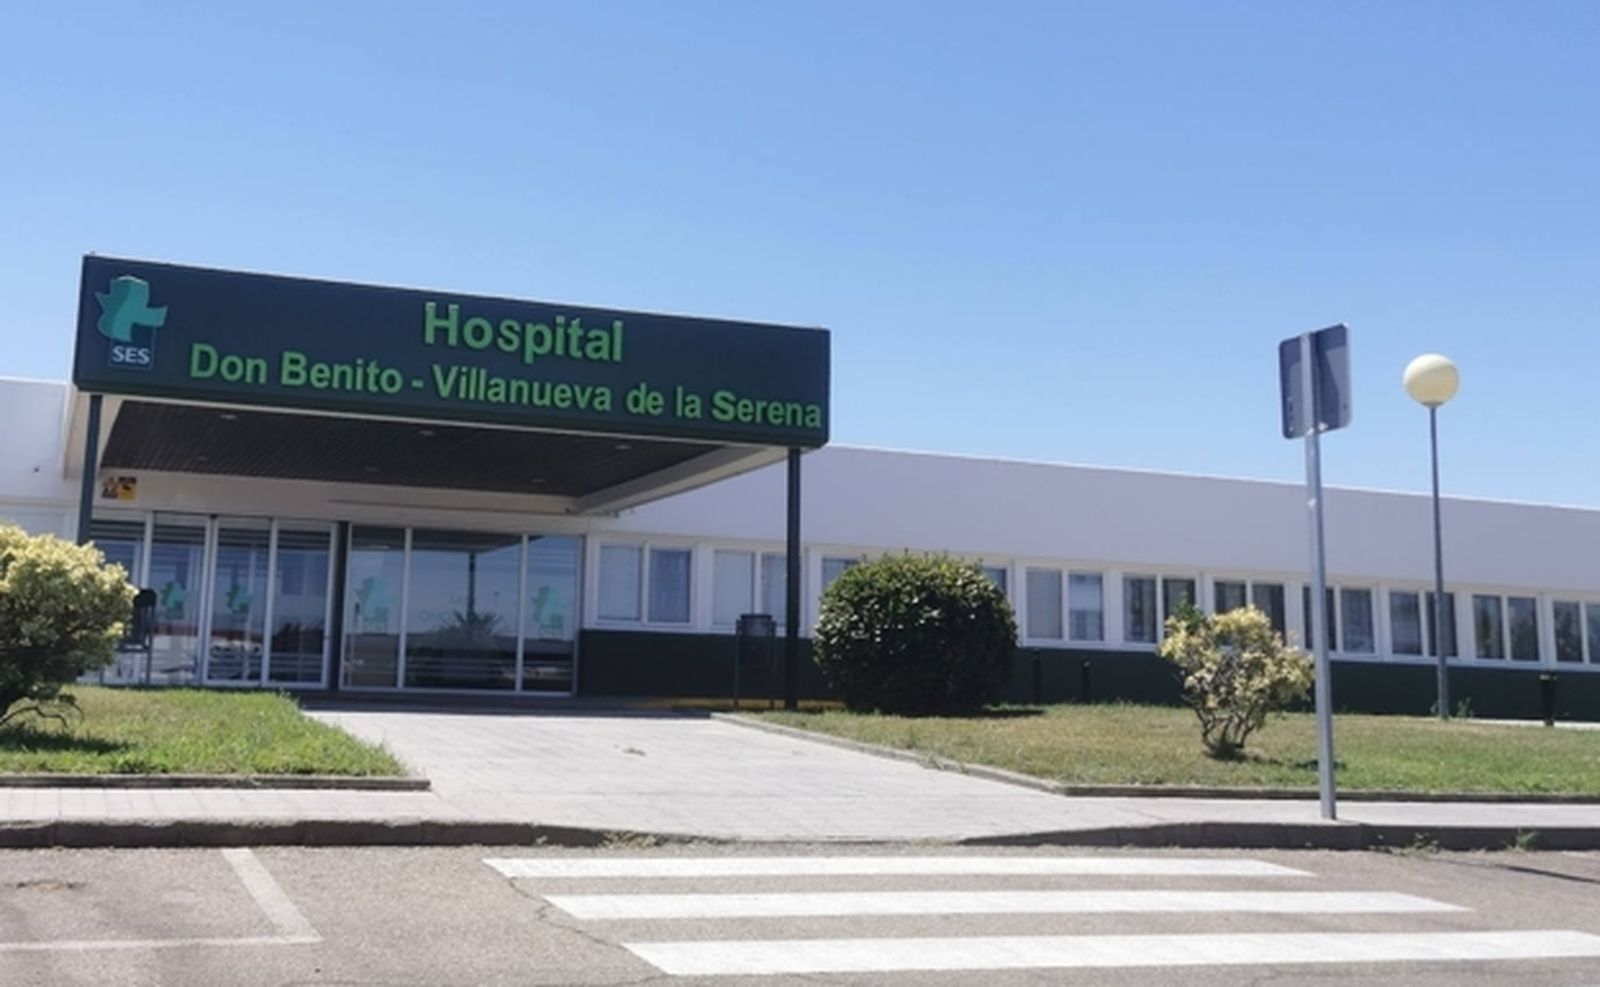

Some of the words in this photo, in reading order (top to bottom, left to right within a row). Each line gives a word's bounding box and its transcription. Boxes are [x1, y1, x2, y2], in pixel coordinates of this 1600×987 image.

[111, 345, 150, 364] SES
[424, 301, 624, 364] Hospital
[190, 343, 267, 384] Don
[281, 352, 403, 393] Benito
[432, 365, 611, 412] Villanueva
[626, 382, 664, 416] de
[675, 386, 702, 419] la
[711, 390, 822, 429] Serena
